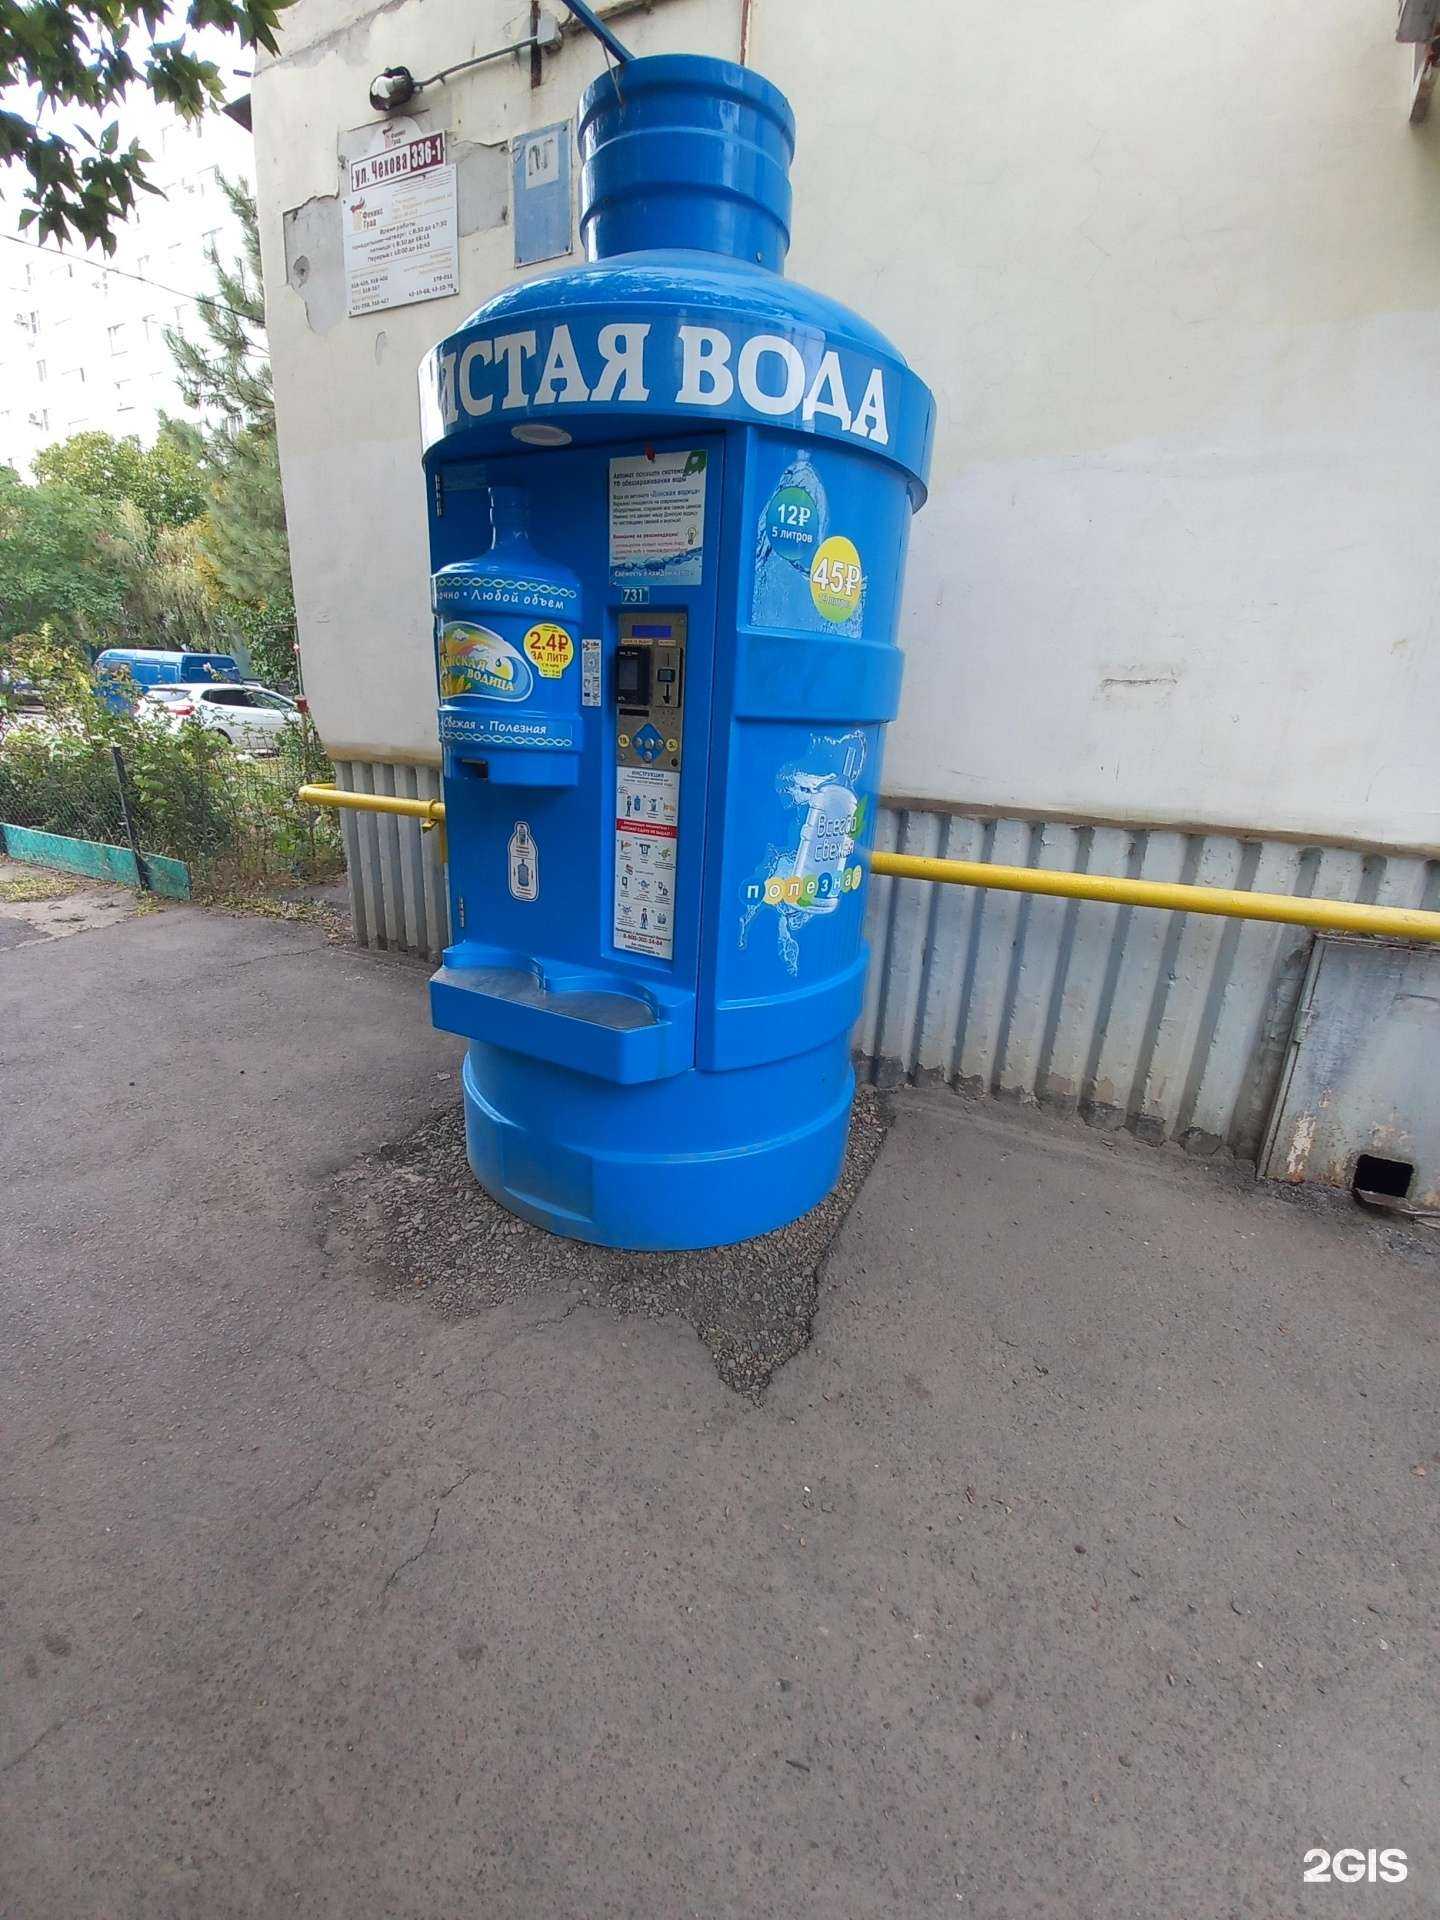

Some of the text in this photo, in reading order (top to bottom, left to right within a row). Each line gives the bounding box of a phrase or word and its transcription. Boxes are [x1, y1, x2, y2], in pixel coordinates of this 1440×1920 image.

[355, 169, 370, 187] ул.
[371, 152, 408, 179] Чехова
[410, 137, 443, 168] 336-1
[430, 323, 890, 445] ИСТАЯ ВОДА
[777, 504, 811, 526] 12₽
[771, 526, 813, 544] 5 литров
[812, 558, 860, 597] 45₽
[471, 589, 519, 603] Любой
[623, 589, 643, 602] 731
[531, 650, 569, 664] ЗА ЛИТР
[467, 668, 515, 692] ВОДИЦА
[489, 720, 547, 735] Полезная
[746, 871, 860, 898] полезна
